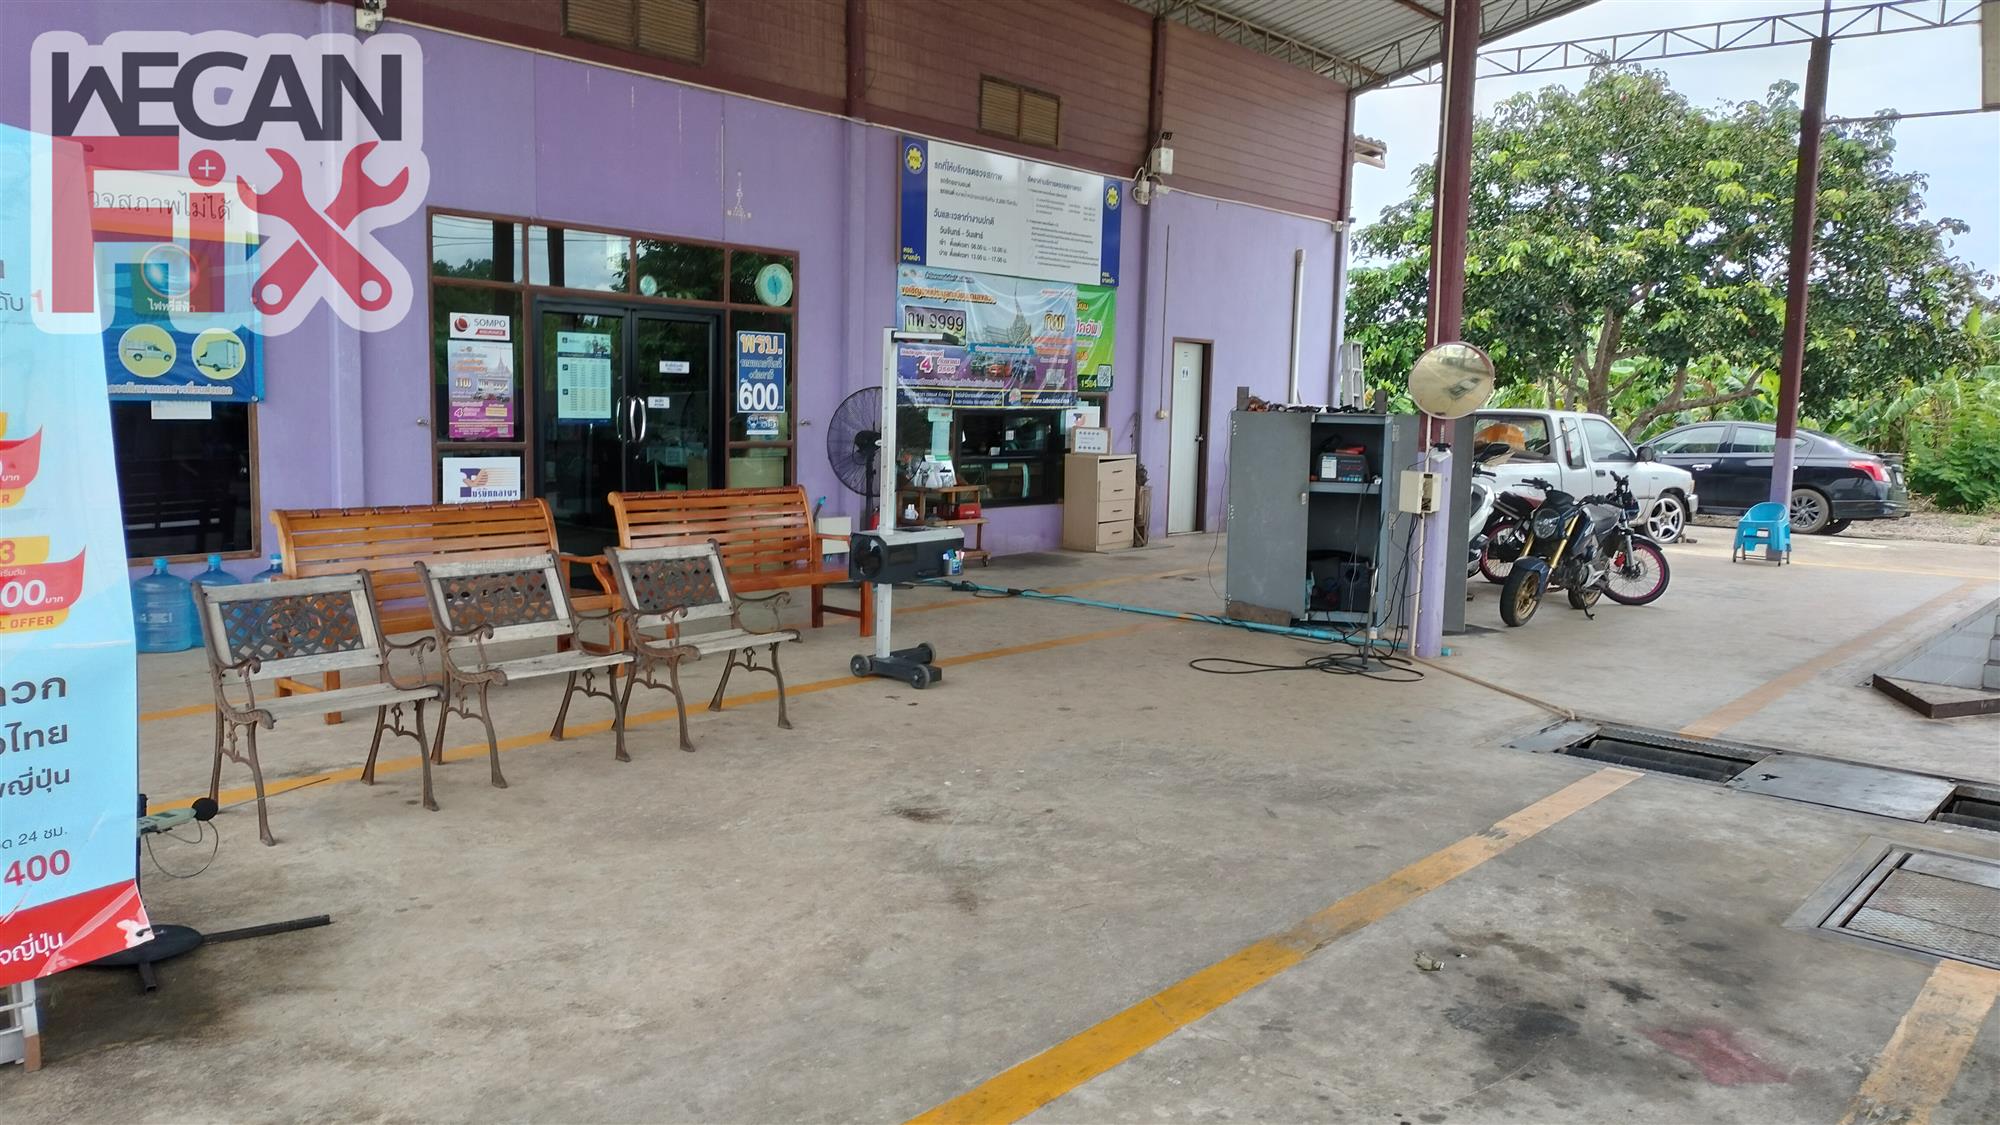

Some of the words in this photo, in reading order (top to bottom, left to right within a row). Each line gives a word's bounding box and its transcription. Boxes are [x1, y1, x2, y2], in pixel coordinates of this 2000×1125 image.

[474, 318, 506, 328] SOMPO
[907, 312, 925, 328] กพ
[929, 313, 964, 332] 9999
[739, 334, 783, 355] พรบ.
[919, 356, 933, 374] 4
[740, 382, 779, 411] 600
[45, 596, 64, 604] บาท
[10, 615, 54, 629] OFFER
[0, 676, 66, 708] วก
[18, 831, 38, 846] 24
[4, 849, 71, 887] 400
